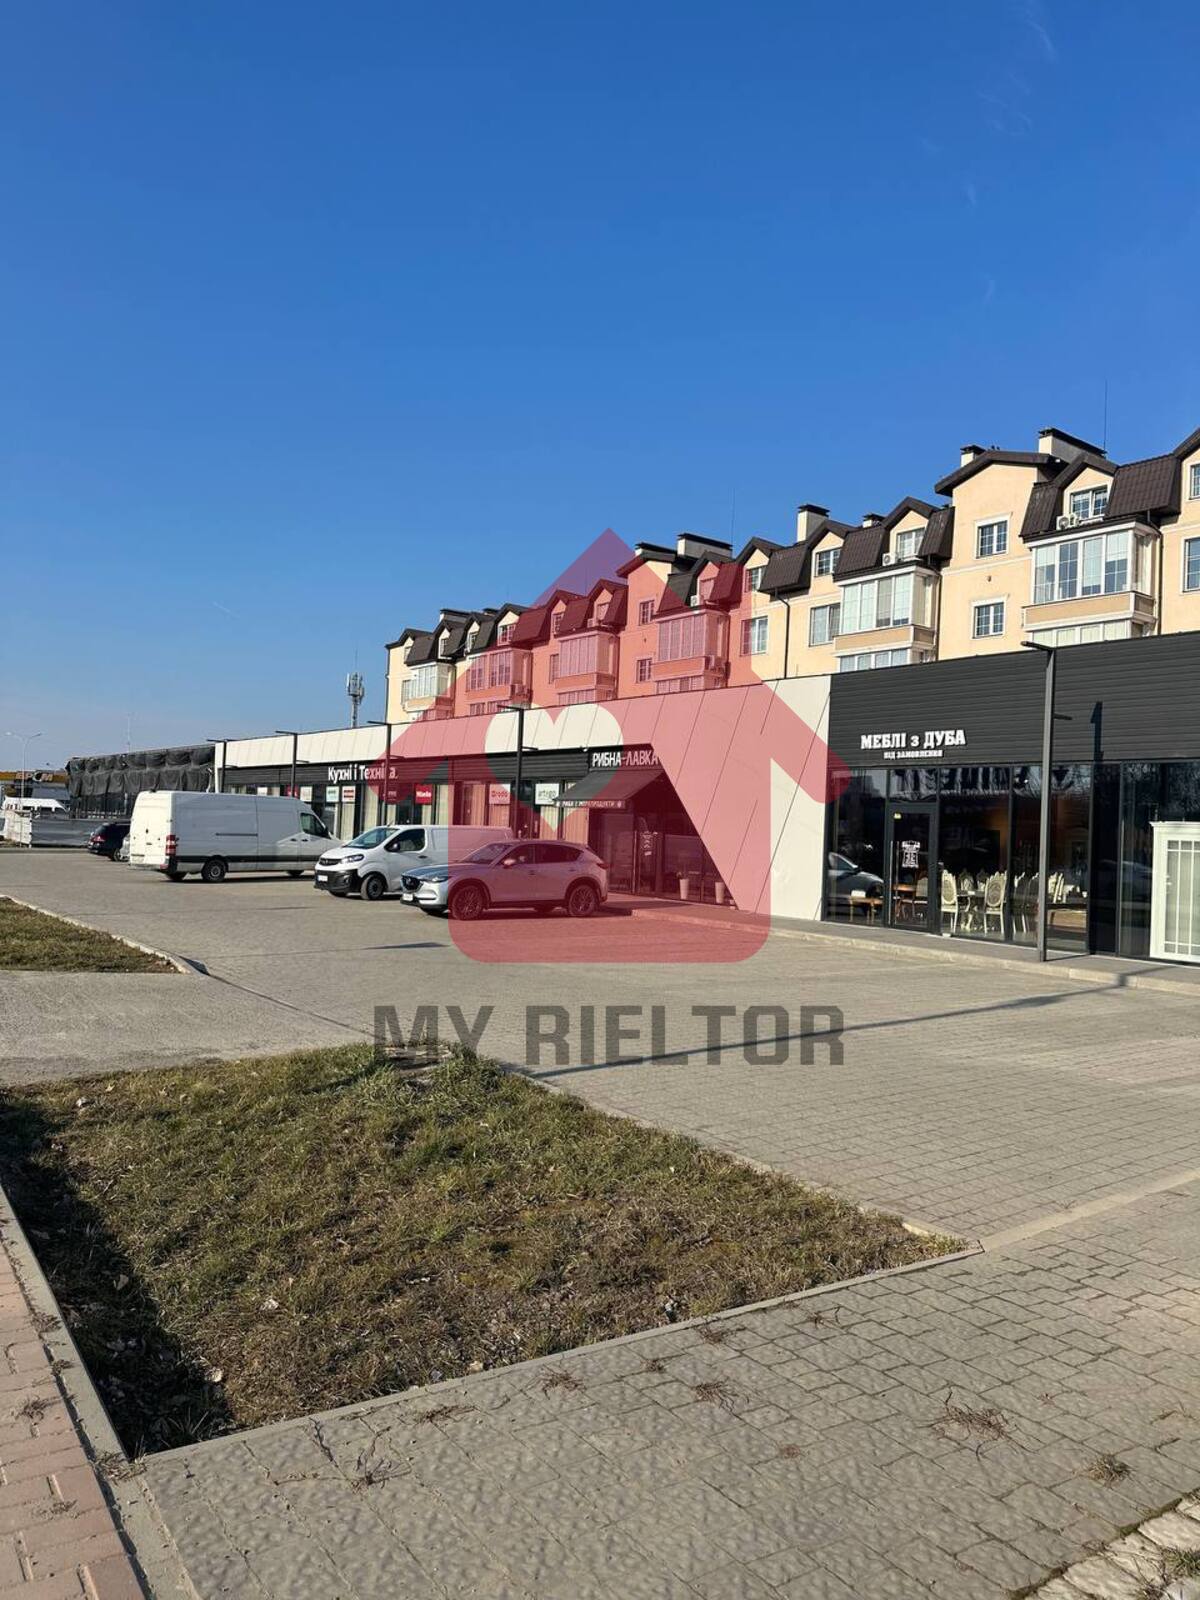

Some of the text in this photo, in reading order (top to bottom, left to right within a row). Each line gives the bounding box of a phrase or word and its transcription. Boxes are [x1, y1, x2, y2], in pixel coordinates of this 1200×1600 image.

[861, 730, 966, 749] МЕБЛІ з ДУБА
[328, 764, 352, 784] Кухні
[359, 762, 398, 780] Техніа.
